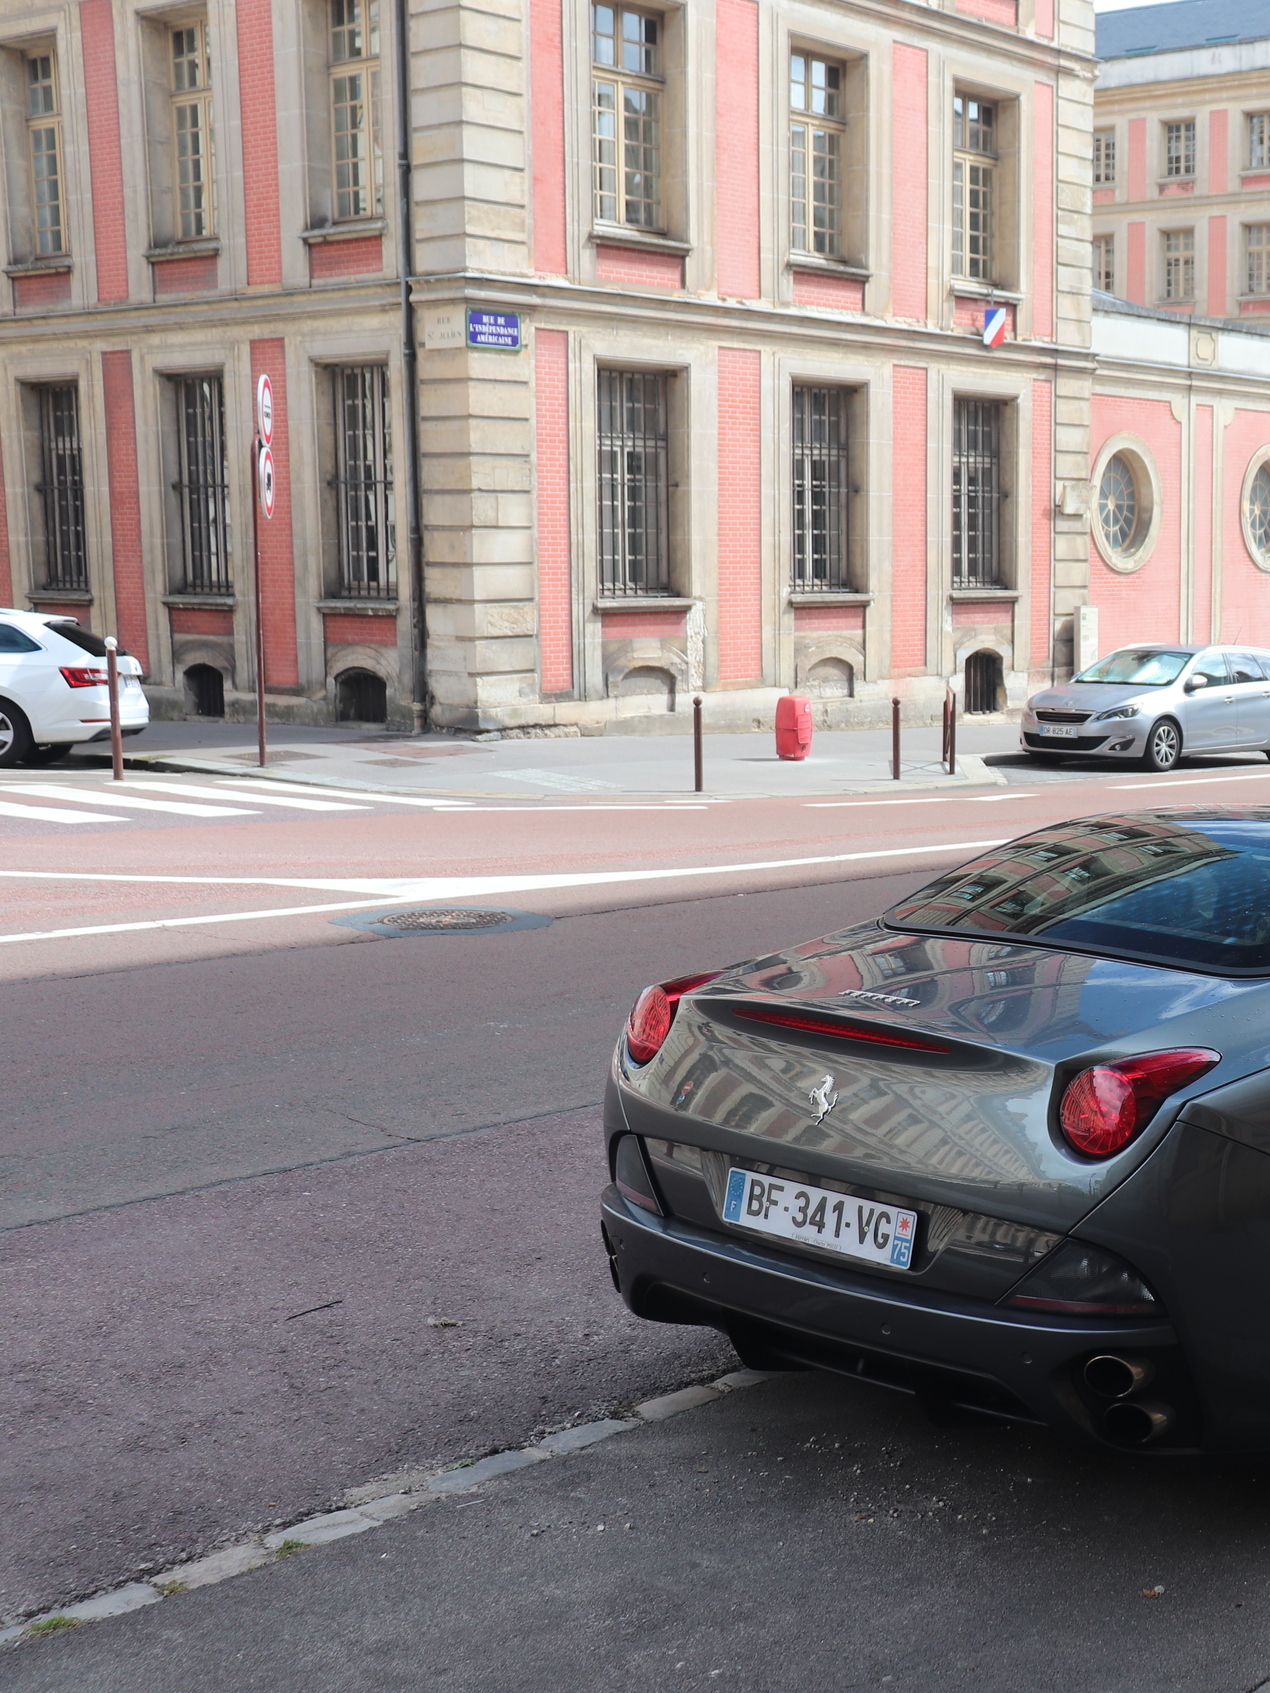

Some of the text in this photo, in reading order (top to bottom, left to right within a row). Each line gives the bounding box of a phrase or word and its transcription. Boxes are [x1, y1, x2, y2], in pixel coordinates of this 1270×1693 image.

[482, 314, 506, 324] RUE DE
[469, 322, 518, 336] L'INDÉPENDANCE
[476, 332, 513, 345] AMÉRICAINE
[730, 1200, 737, 1212] F
[746, 1178, 892, 1250] BF-341-VG
[893, 1239, 909, 1263] 75
